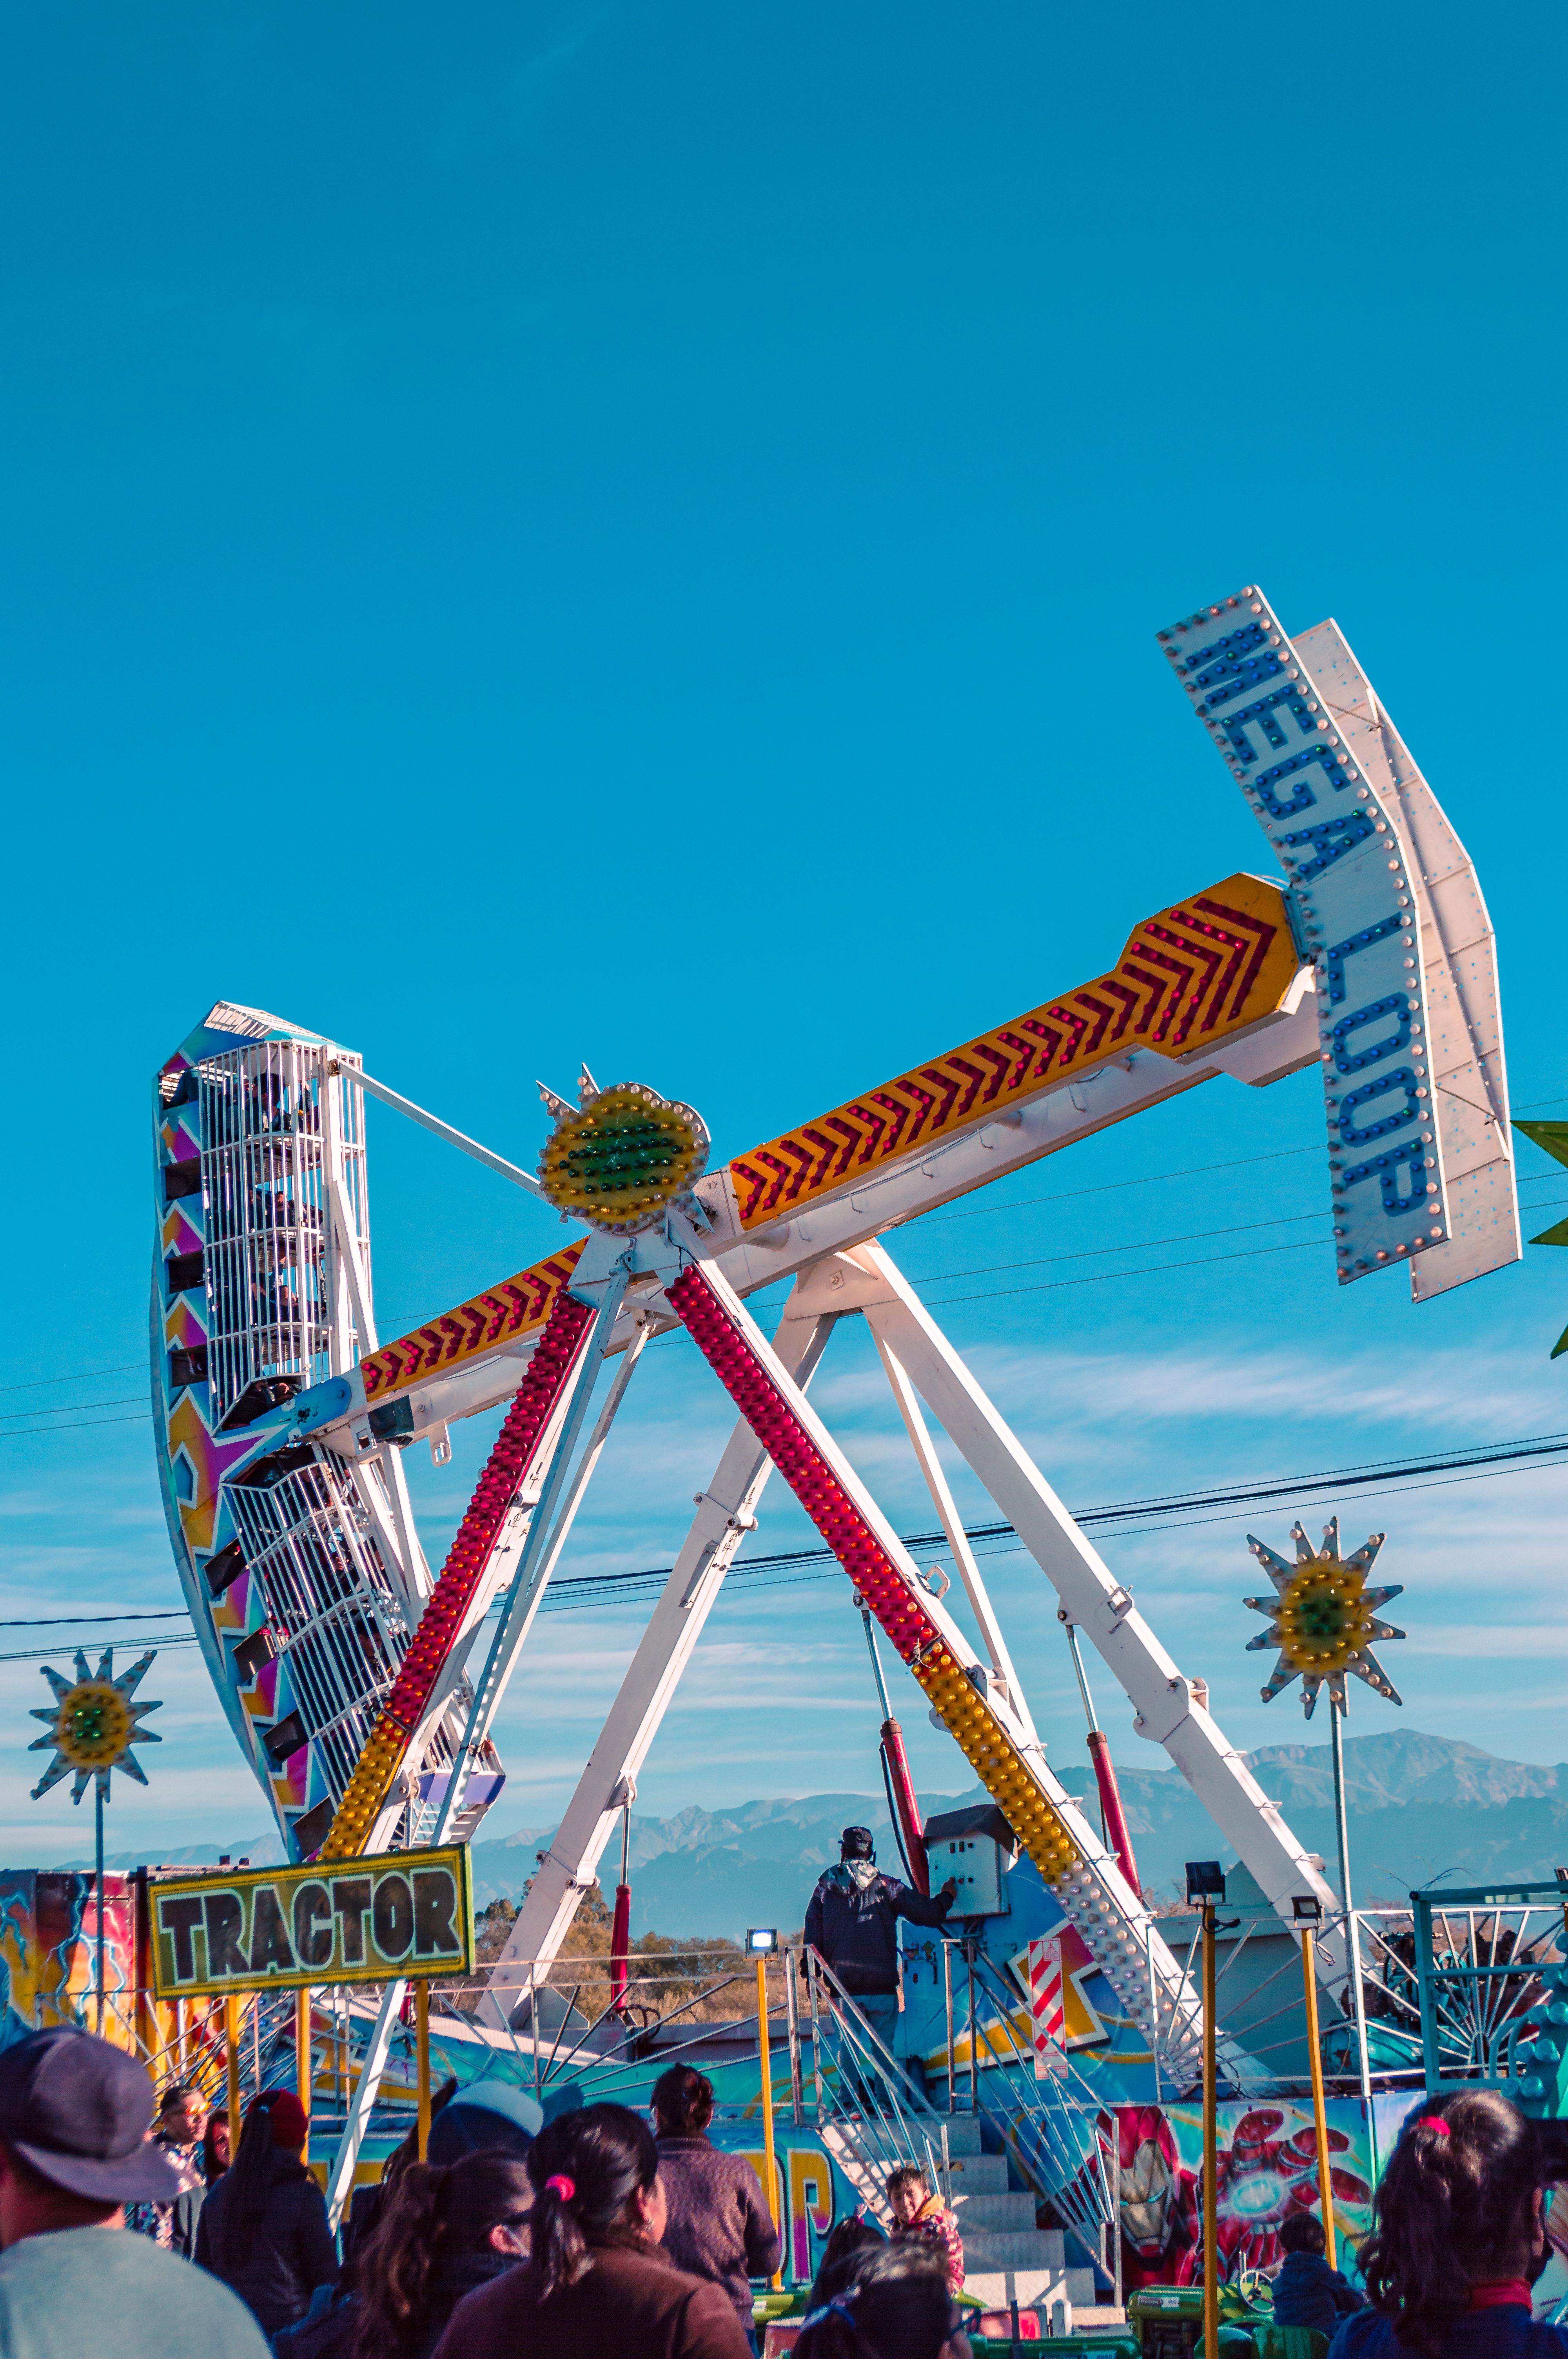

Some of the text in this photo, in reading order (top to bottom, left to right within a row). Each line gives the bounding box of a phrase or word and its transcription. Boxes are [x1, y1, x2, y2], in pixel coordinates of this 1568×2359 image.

[1185, 622, 1427, 1217] MEGA LOOP
[157, 1867, 463, 1985] TRACTOR
